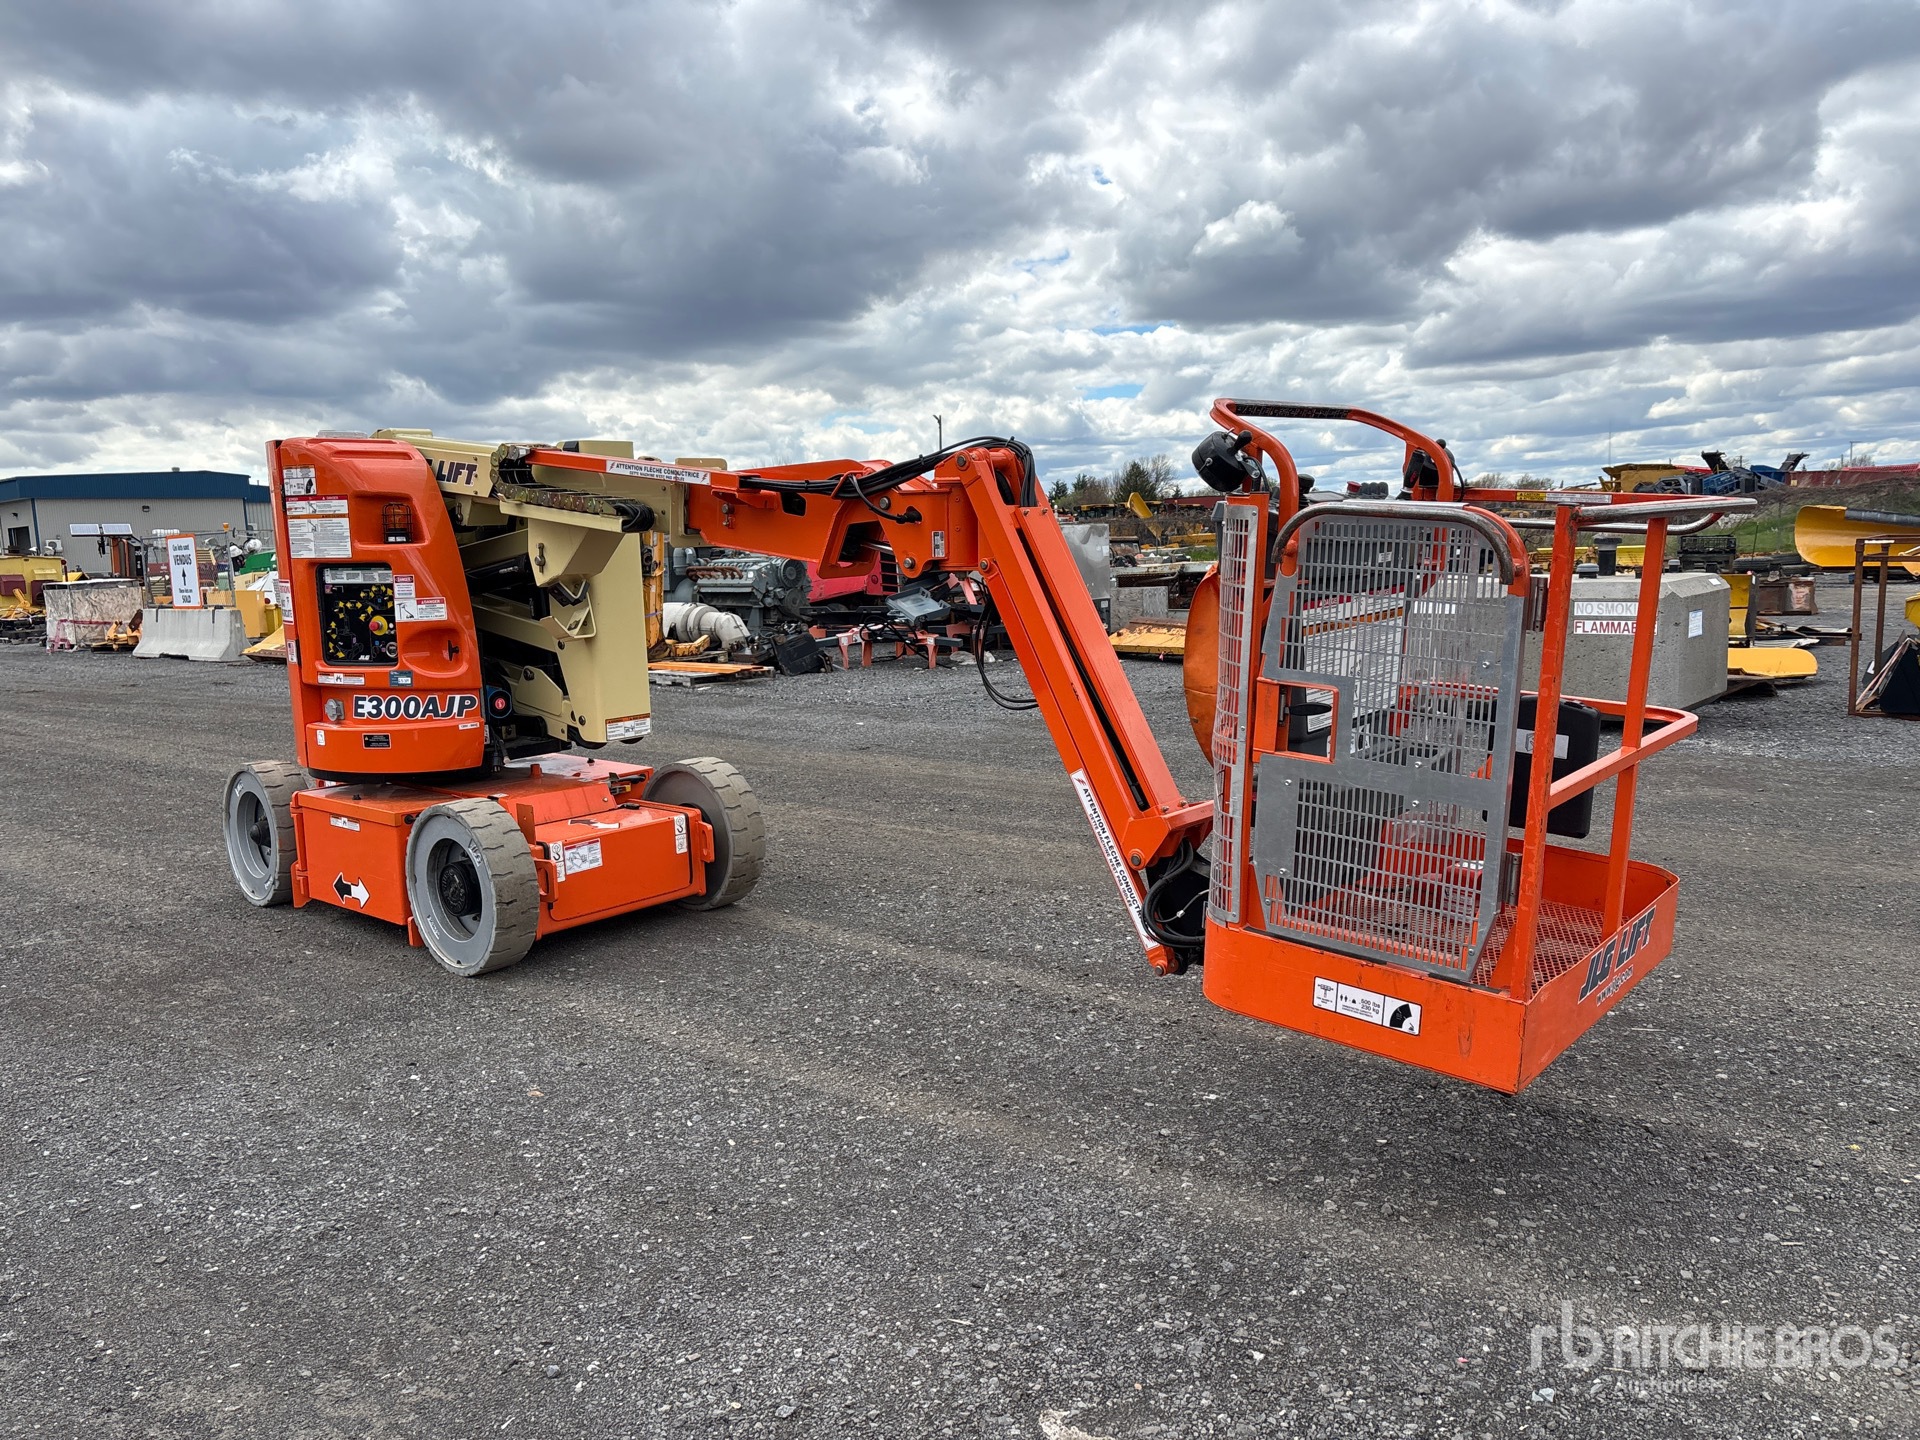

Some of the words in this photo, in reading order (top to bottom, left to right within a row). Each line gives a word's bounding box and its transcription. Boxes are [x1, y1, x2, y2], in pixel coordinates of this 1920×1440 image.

[436, 460, 477, 485] LIFT
[616, 463, 642, 471] ATTENTION
[664, 468, 699, 478] CONDUCTRICE
[173, 554, 192, 566] VENDUS
[1576, 602, 1594, 615] NO
[1597, 602, 1637, 615] SMOKI
[353, 695, 478, 719] E300AJP
[1083, 788, 1107, 834] ATTENTION
[1097, 831, 1111, 857] MACHINE
[1578, 935, 1618, 1004] JLG
[1614, 905, 1657, 973] LIFT
[1360, 998, 1371, 1006] 500
